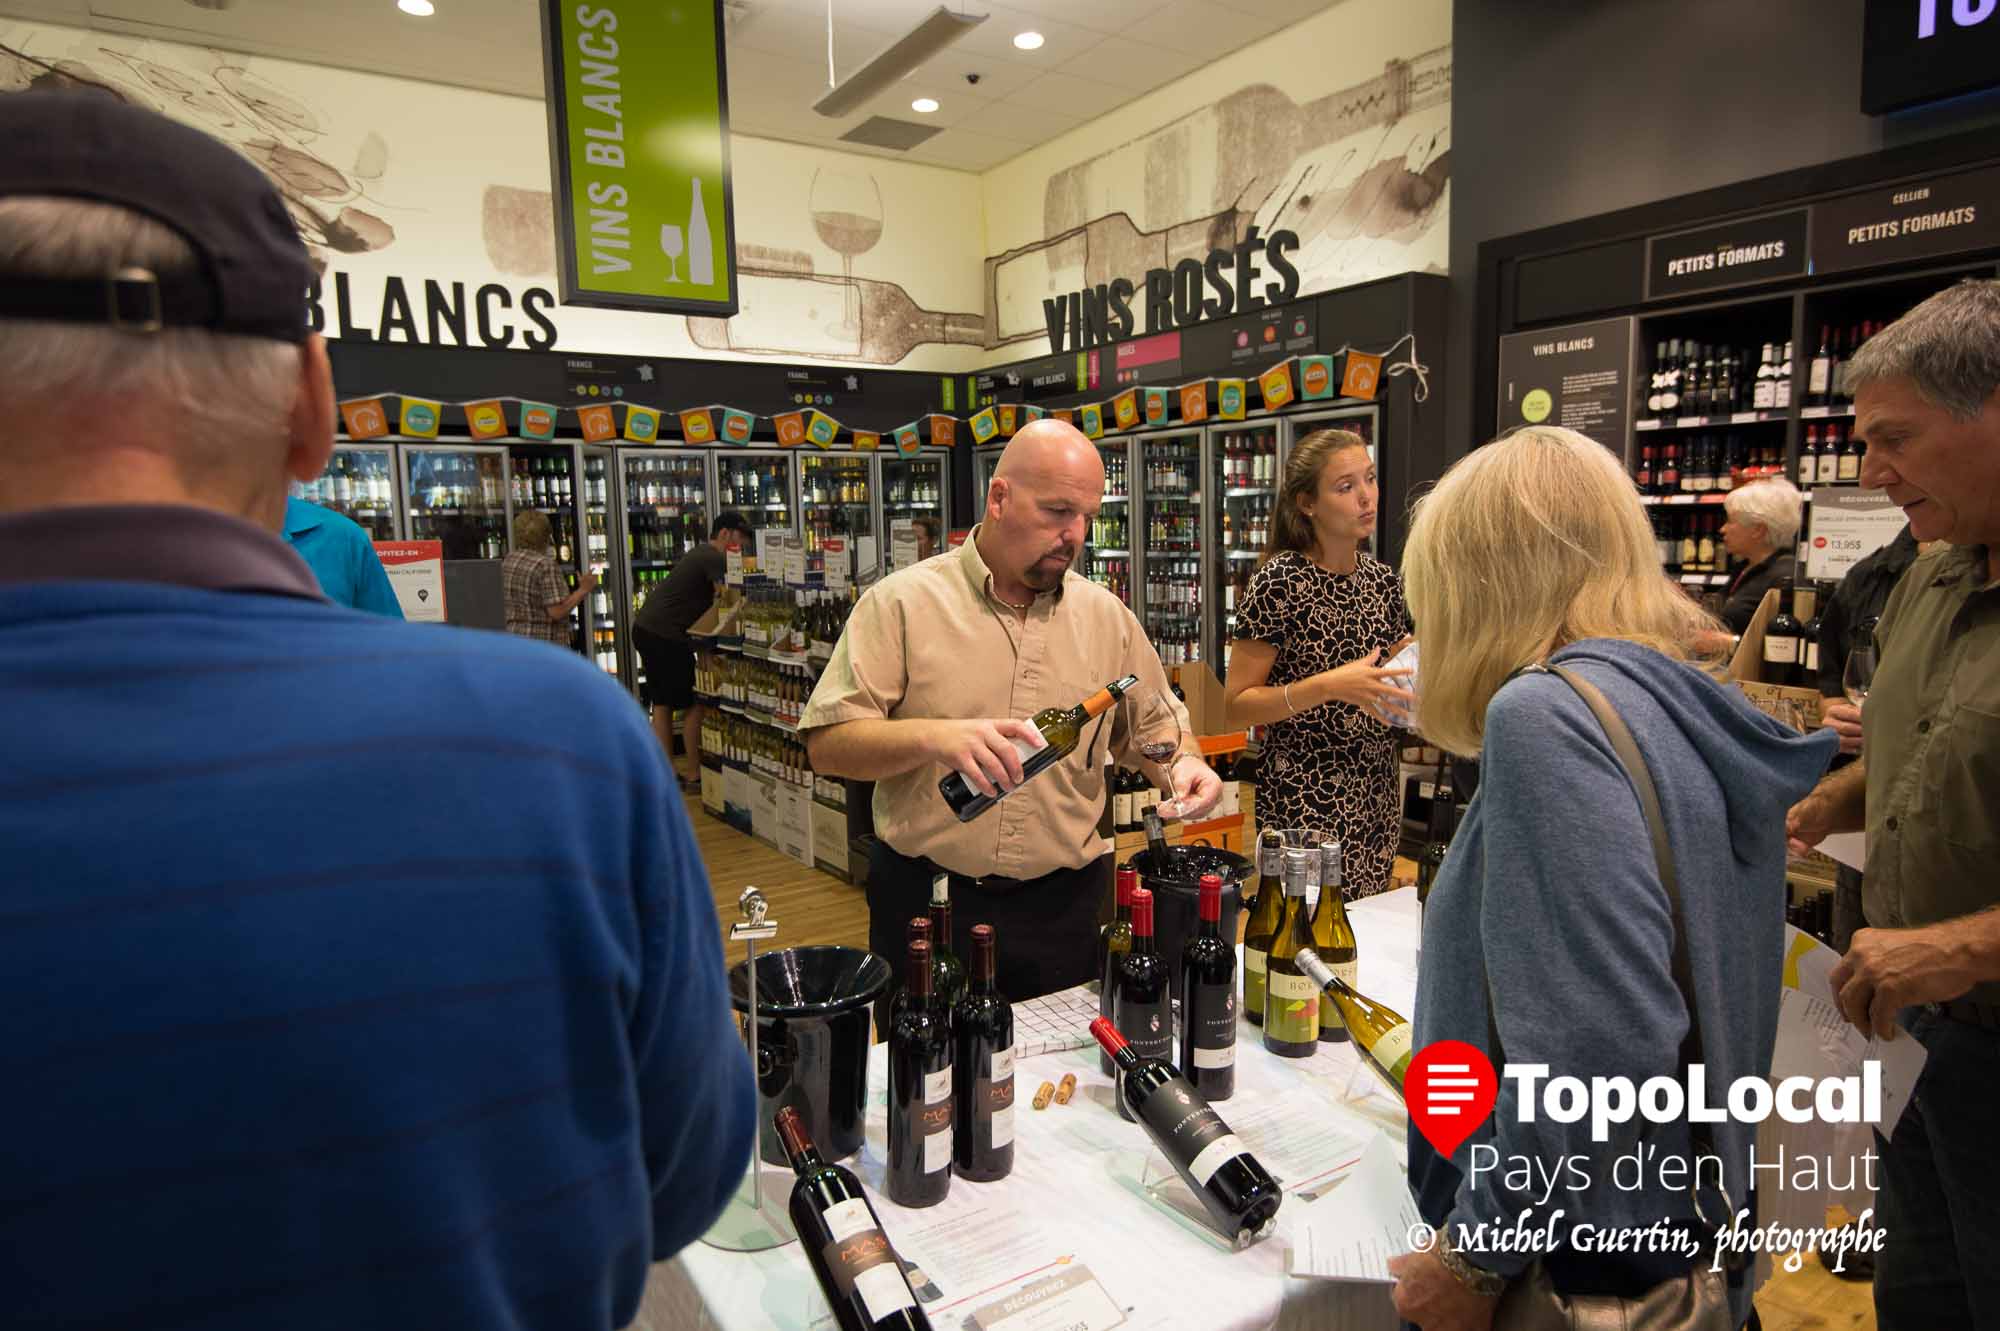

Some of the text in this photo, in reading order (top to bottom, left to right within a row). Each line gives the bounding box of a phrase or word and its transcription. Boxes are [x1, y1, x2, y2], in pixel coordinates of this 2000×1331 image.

[576, 5, 632, 275] VINS BLANCS
[1893, 188, 1930, 205] CELLIER
[1848, 206, 1976, 245] PETITS FORMATS
[1668, 240, 1784, 277] PETITS FORMATS
[1043, 226, 1300, 353] VINS ROSÉS
[1533, 336, 1595, 356] VINS BLANCS
